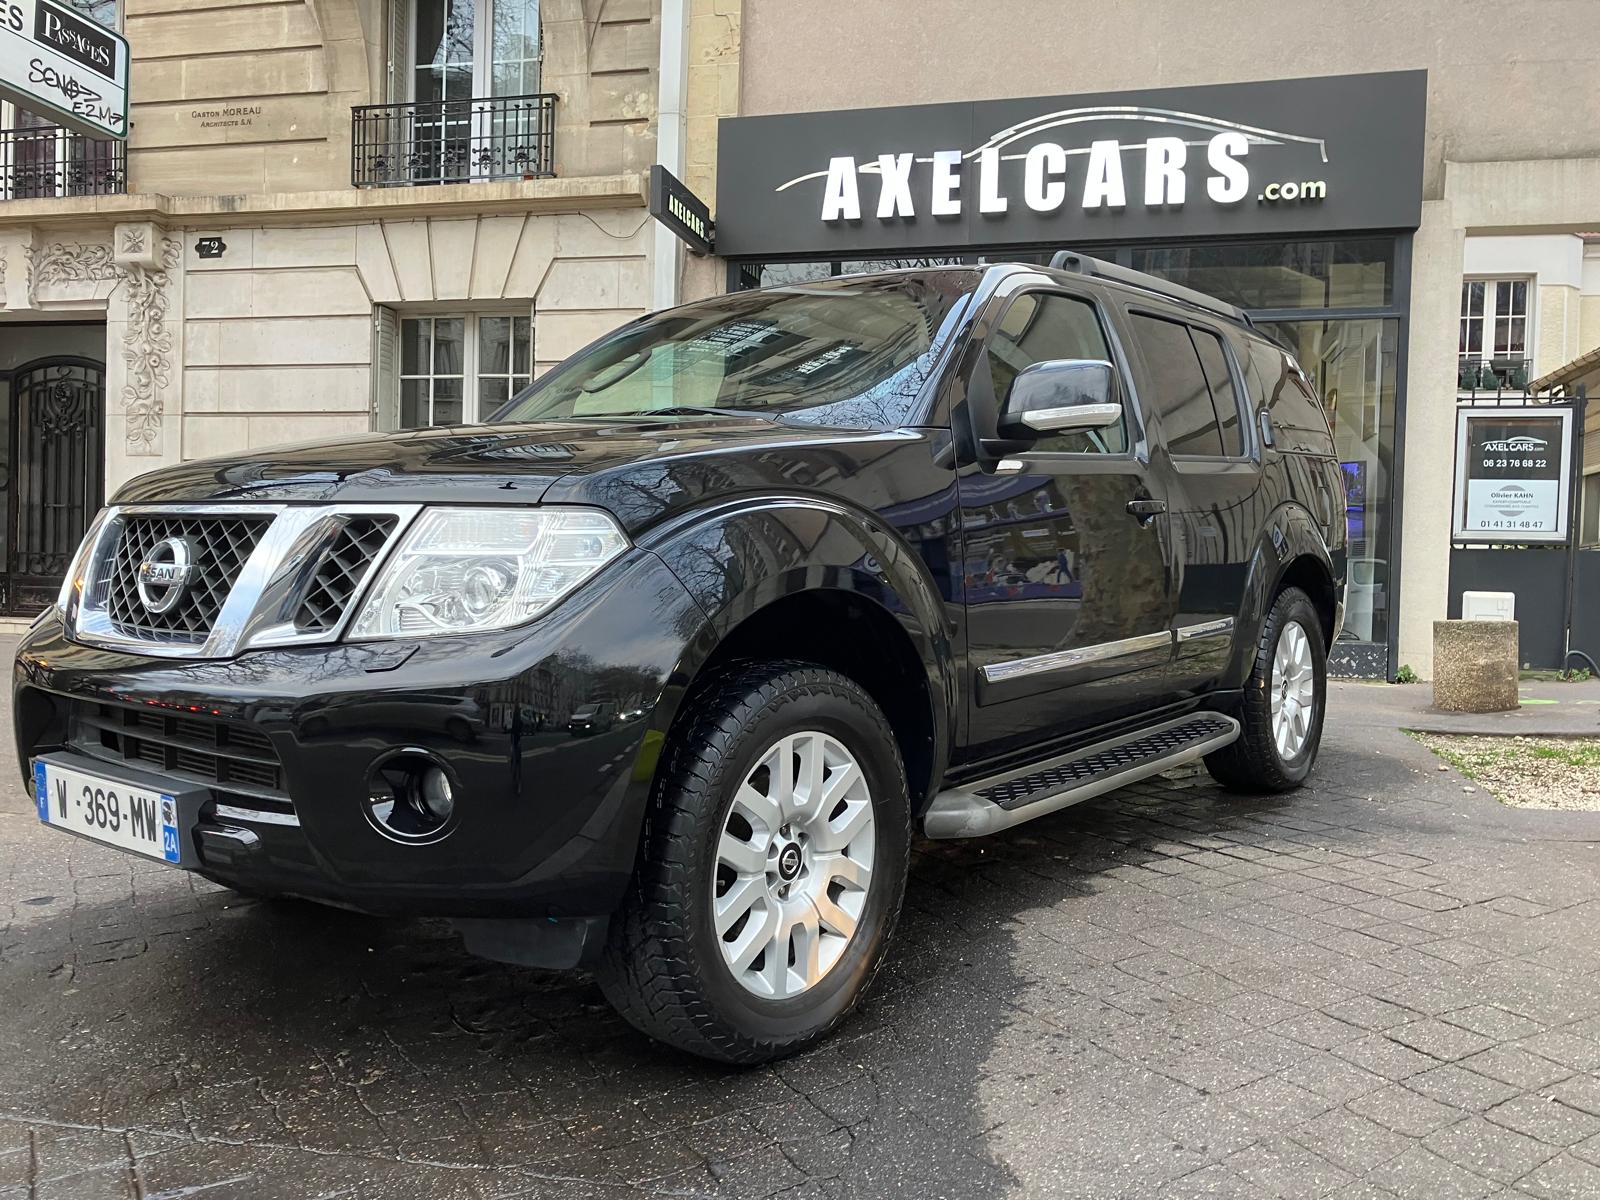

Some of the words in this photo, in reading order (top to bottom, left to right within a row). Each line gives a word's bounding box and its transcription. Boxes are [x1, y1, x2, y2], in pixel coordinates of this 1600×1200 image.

[222, 106, 261, 116] MOREAU
[821, 132, 1249, 221] AXELCARS
[668, 194, 704, 239] AXELCARS
[201, 240, 219, 254] 72
[1483, 459, 1494, 467] 06
[1496, 459, 1507, 467] 23
[1509, 459, 1520, 467] 76
[1535, 459, 1547, 468] 22
[1480, 520, 1490, 528] 01
[1493, 520, 1503, 528] 41
[1506, 520, 1516, 528] 31
[1519, 520, 1530, 528] 48
[1532, 521, 1543, 529] 47
[164, 831, 178, 854] 2A
